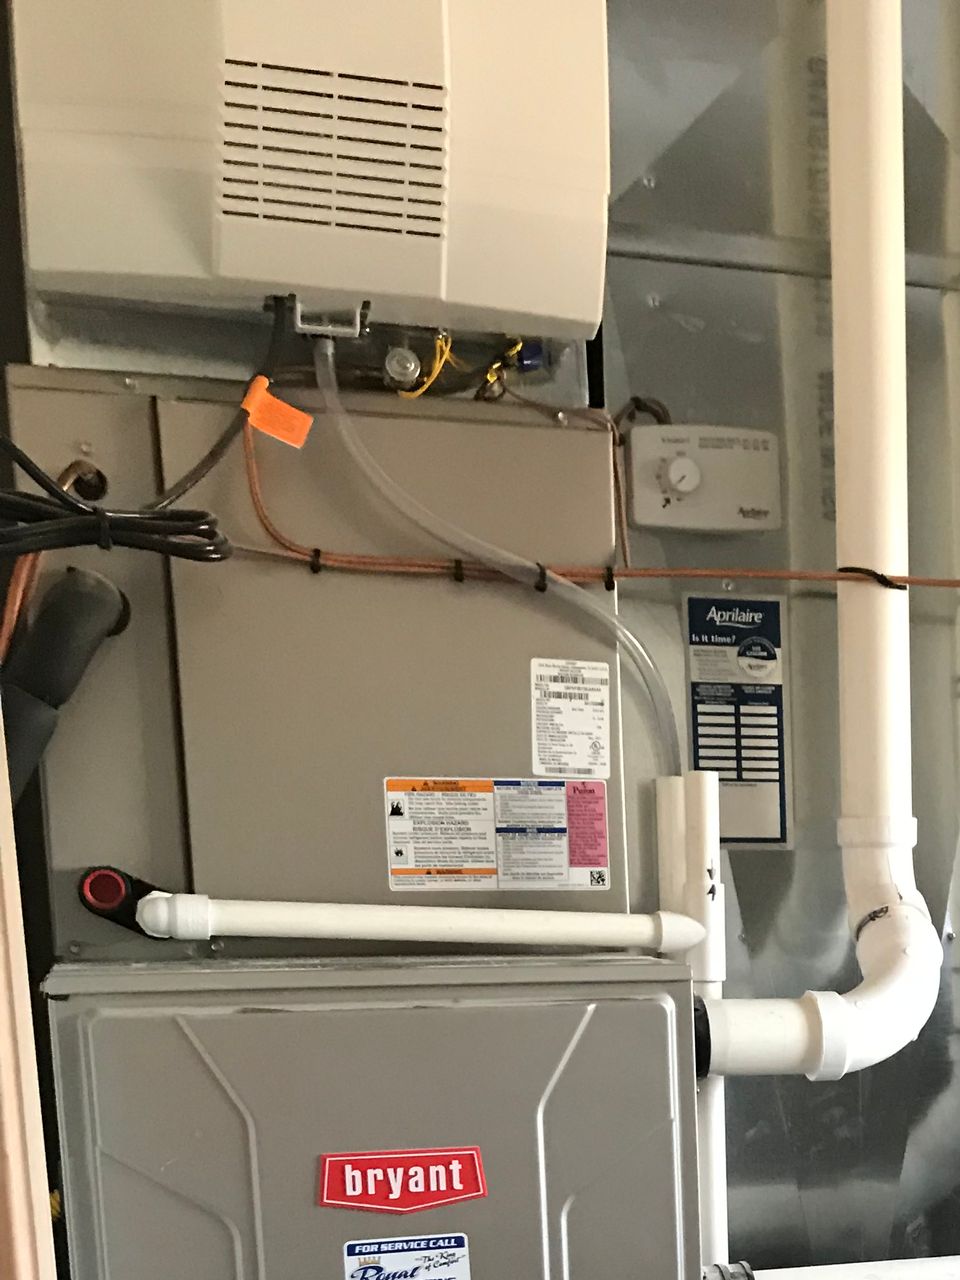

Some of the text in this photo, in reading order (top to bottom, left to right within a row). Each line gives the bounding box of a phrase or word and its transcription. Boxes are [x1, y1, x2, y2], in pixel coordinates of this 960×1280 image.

[706, 605, 763, 626] Aprilaire
[692, 633, 736, 643] Is it time?
[344, 1159, 464, 1200] bryant
[355, 1238, 458, 1254] FOR SERVICE CALL
[422, 1251, 456, 1263] The King
[433, 1258, 460, 1268] Comfort
